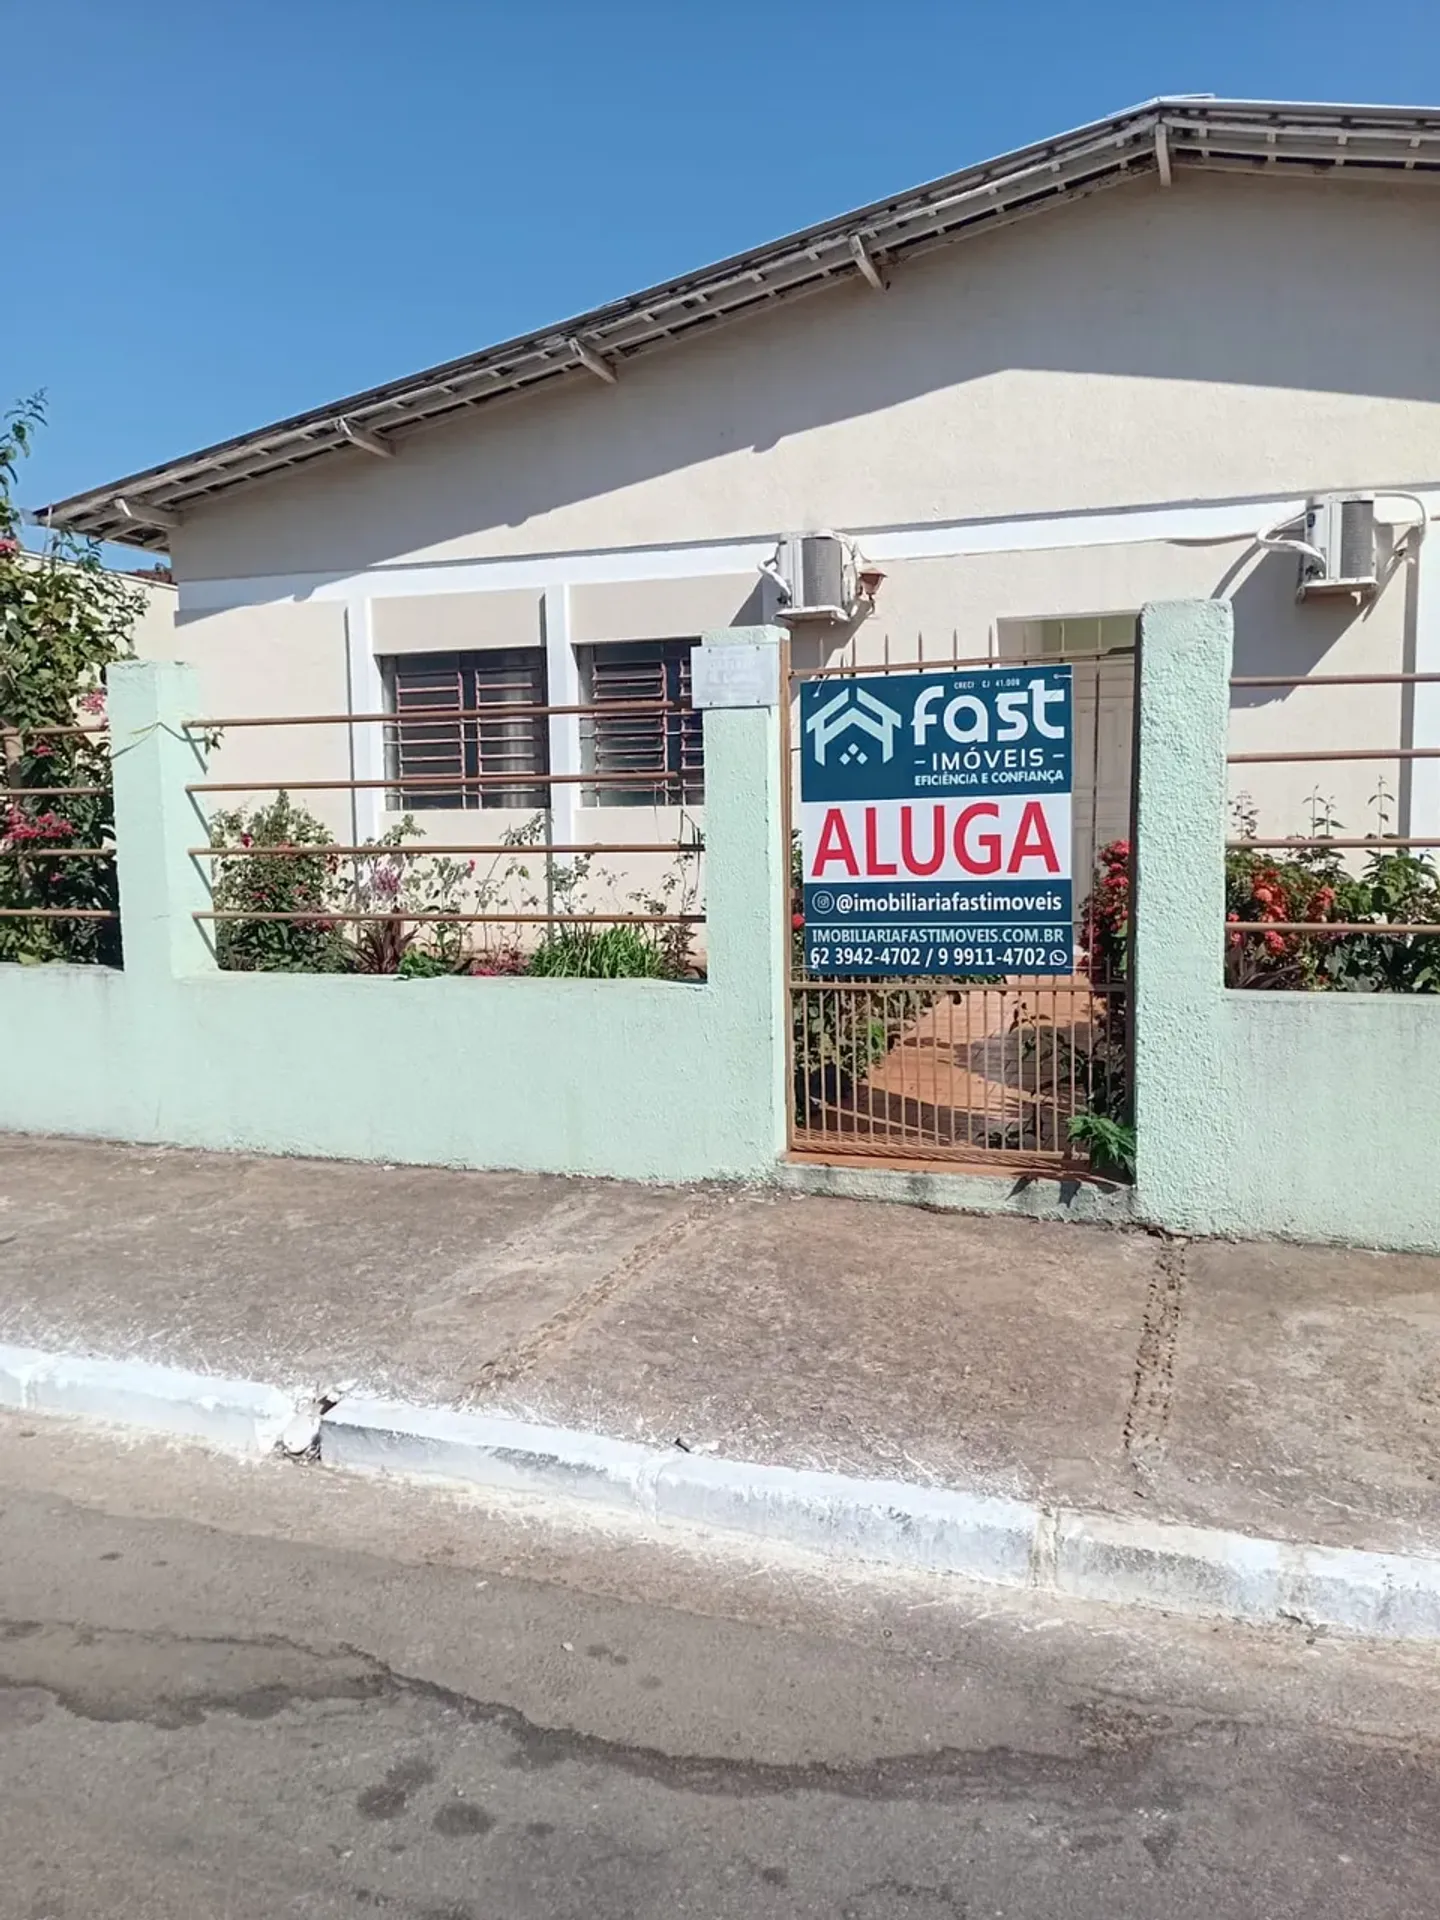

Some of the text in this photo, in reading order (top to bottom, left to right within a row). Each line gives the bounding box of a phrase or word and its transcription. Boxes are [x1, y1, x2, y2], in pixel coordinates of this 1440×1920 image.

[912, 680, 1064, 744] fast
[933, 747, 1043, 769] IMÓVEIS
[915, 771, 1063, 785] EFICIÊNCIA E CONFIANÇA
[812, 801, 1060, 875] ALUGA
[836, 892, 1061, 913] @imobiliariafastimoveis
[813, 929, 1063, 943] IMOBILIARIAFASTIMOVEIS.COM.BR
[811, 948, 1045, 966] 62 3942-4702 / 9 9911-4702
